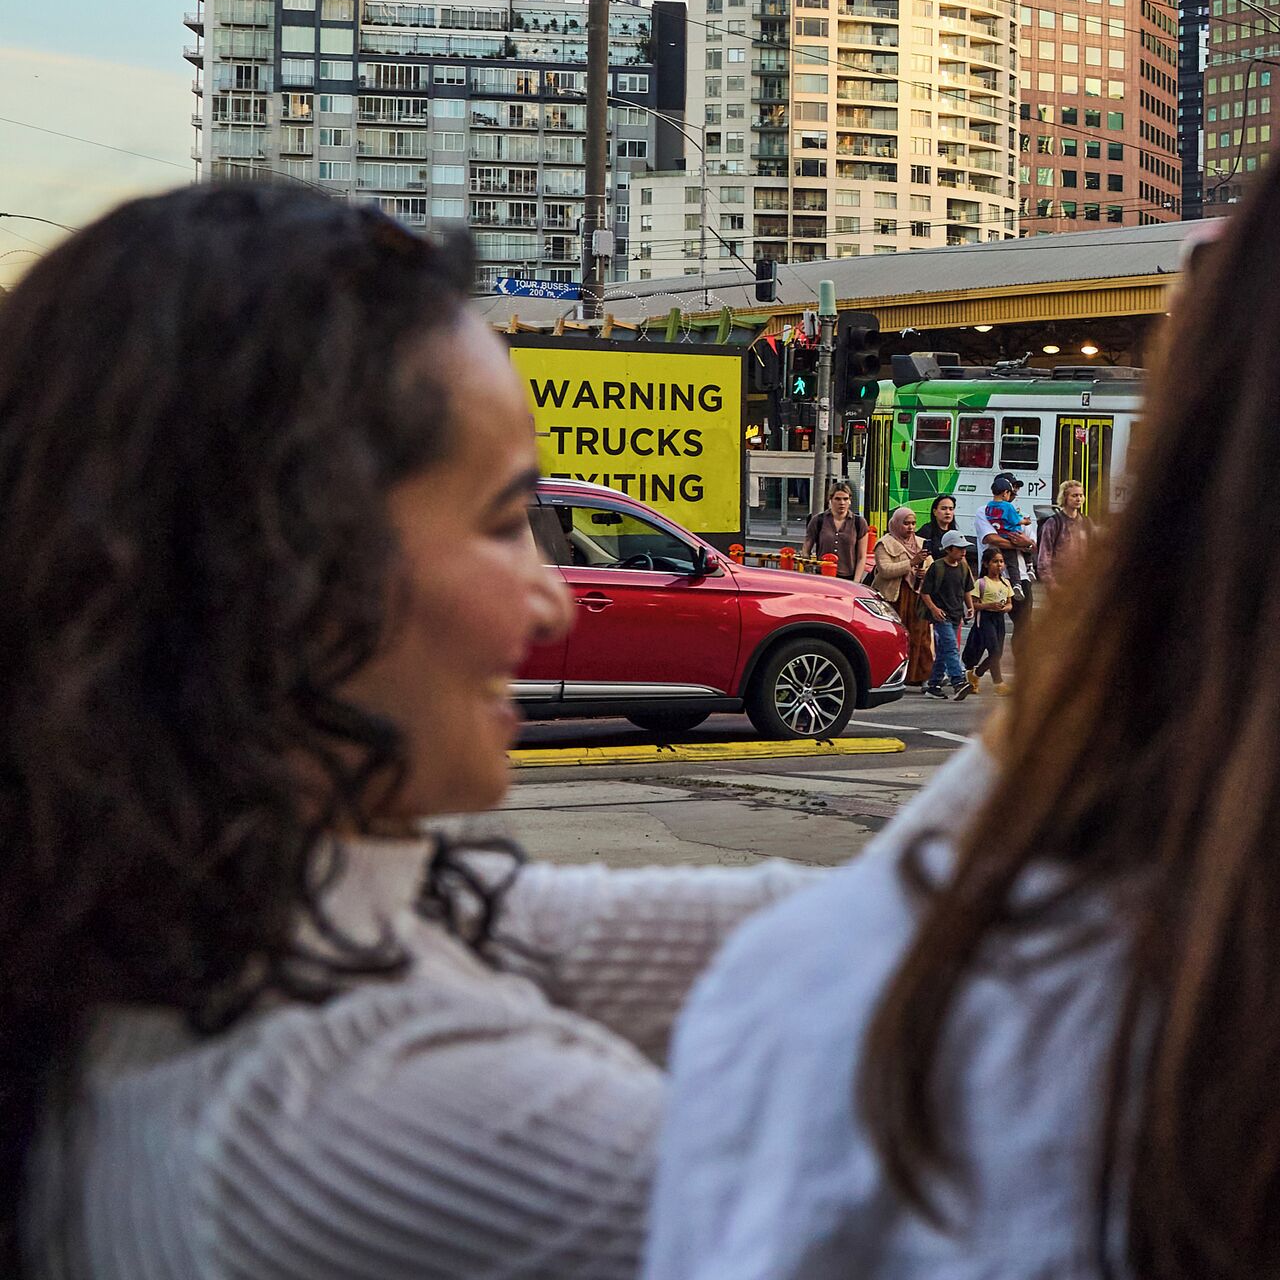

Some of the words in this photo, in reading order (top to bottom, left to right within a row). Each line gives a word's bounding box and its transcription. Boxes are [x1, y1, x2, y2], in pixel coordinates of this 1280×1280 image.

[515, 279, 538, 289] TOUR
[541, 281, 570, 291] BUSES
[529, 288, 544, 297] 200
[530, 378, 723, 412] WARNING
[549, 426, 703, 457] TRUCKS
[550, 473, 704, 502] TING
